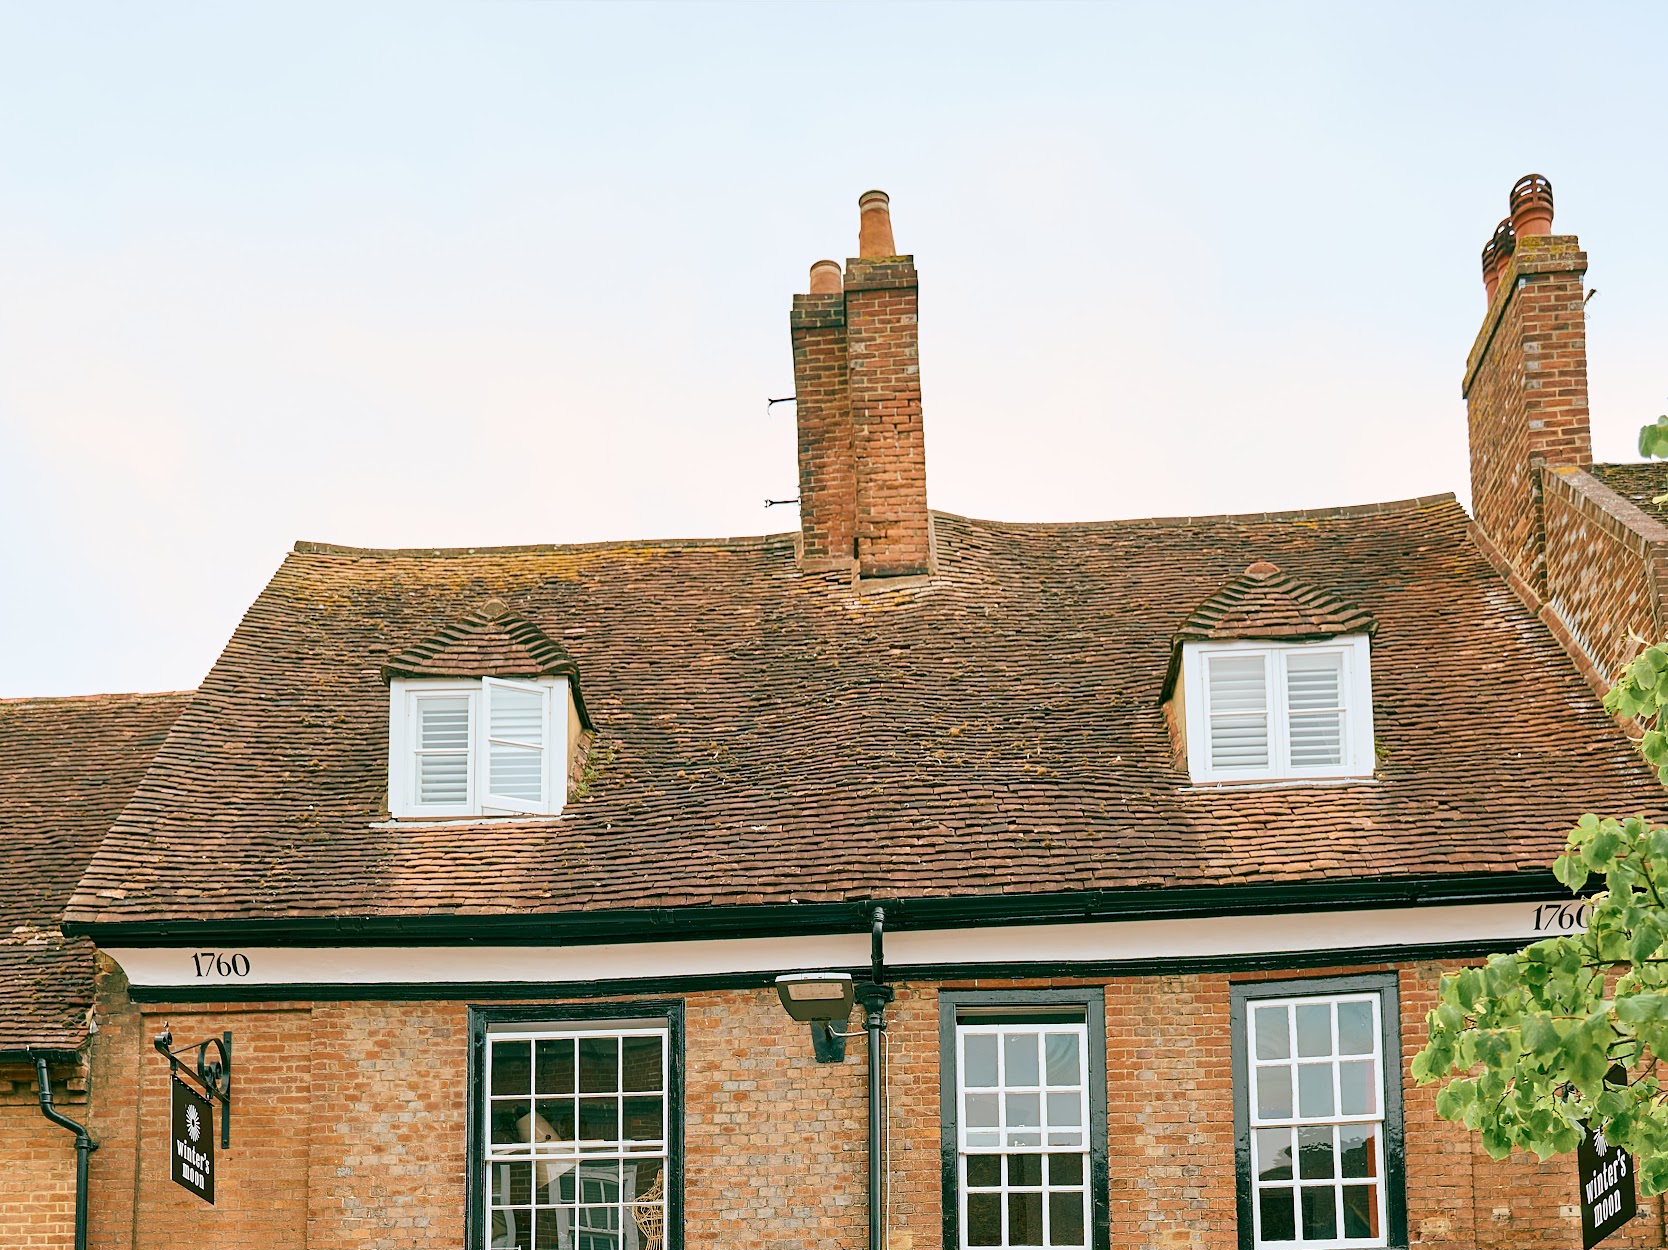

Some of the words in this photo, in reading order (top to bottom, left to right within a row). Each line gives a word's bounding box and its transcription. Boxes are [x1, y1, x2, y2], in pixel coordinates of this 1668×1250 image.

[1532, 903, 1595, 931] 1760
[191, 952, 250, 977] 1760
[176, 1138, 210, 1175] winter's
[182, 1162, 205, 1190] moon
[1585, 1148, 1627, 1205] winter's
[1593, 1189, 1622, 1228] moon
